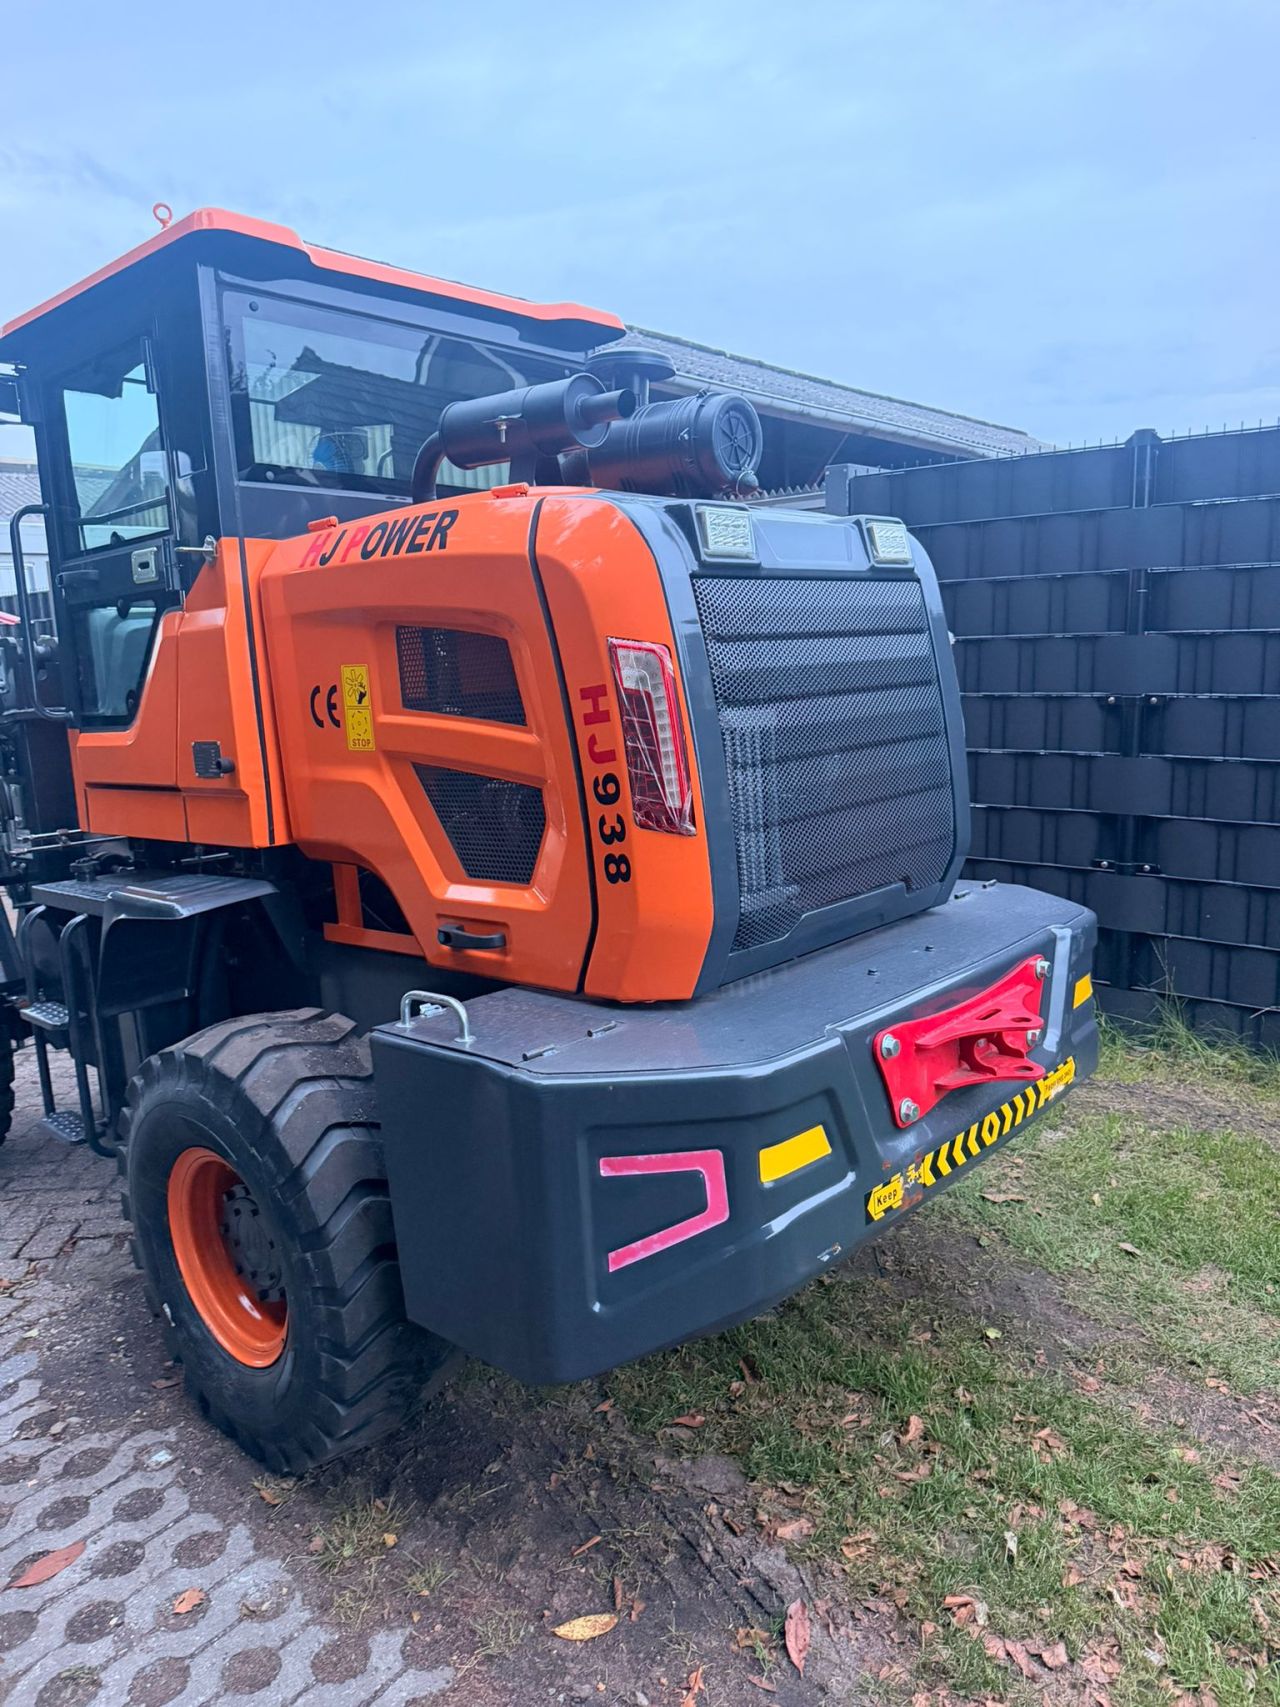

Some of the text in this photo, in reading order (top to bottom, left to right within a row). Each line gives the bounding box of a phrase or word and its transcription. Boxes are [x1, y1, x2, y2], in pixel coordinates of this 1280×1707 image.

[299, 509, 460, 568] HJ POWER
[309, 684, 341, 728] CE
[352, 738, 371, 747] STOP
[579, 683, 632, 885] HJ938
[876, 1188, 898, 1207] Keep
